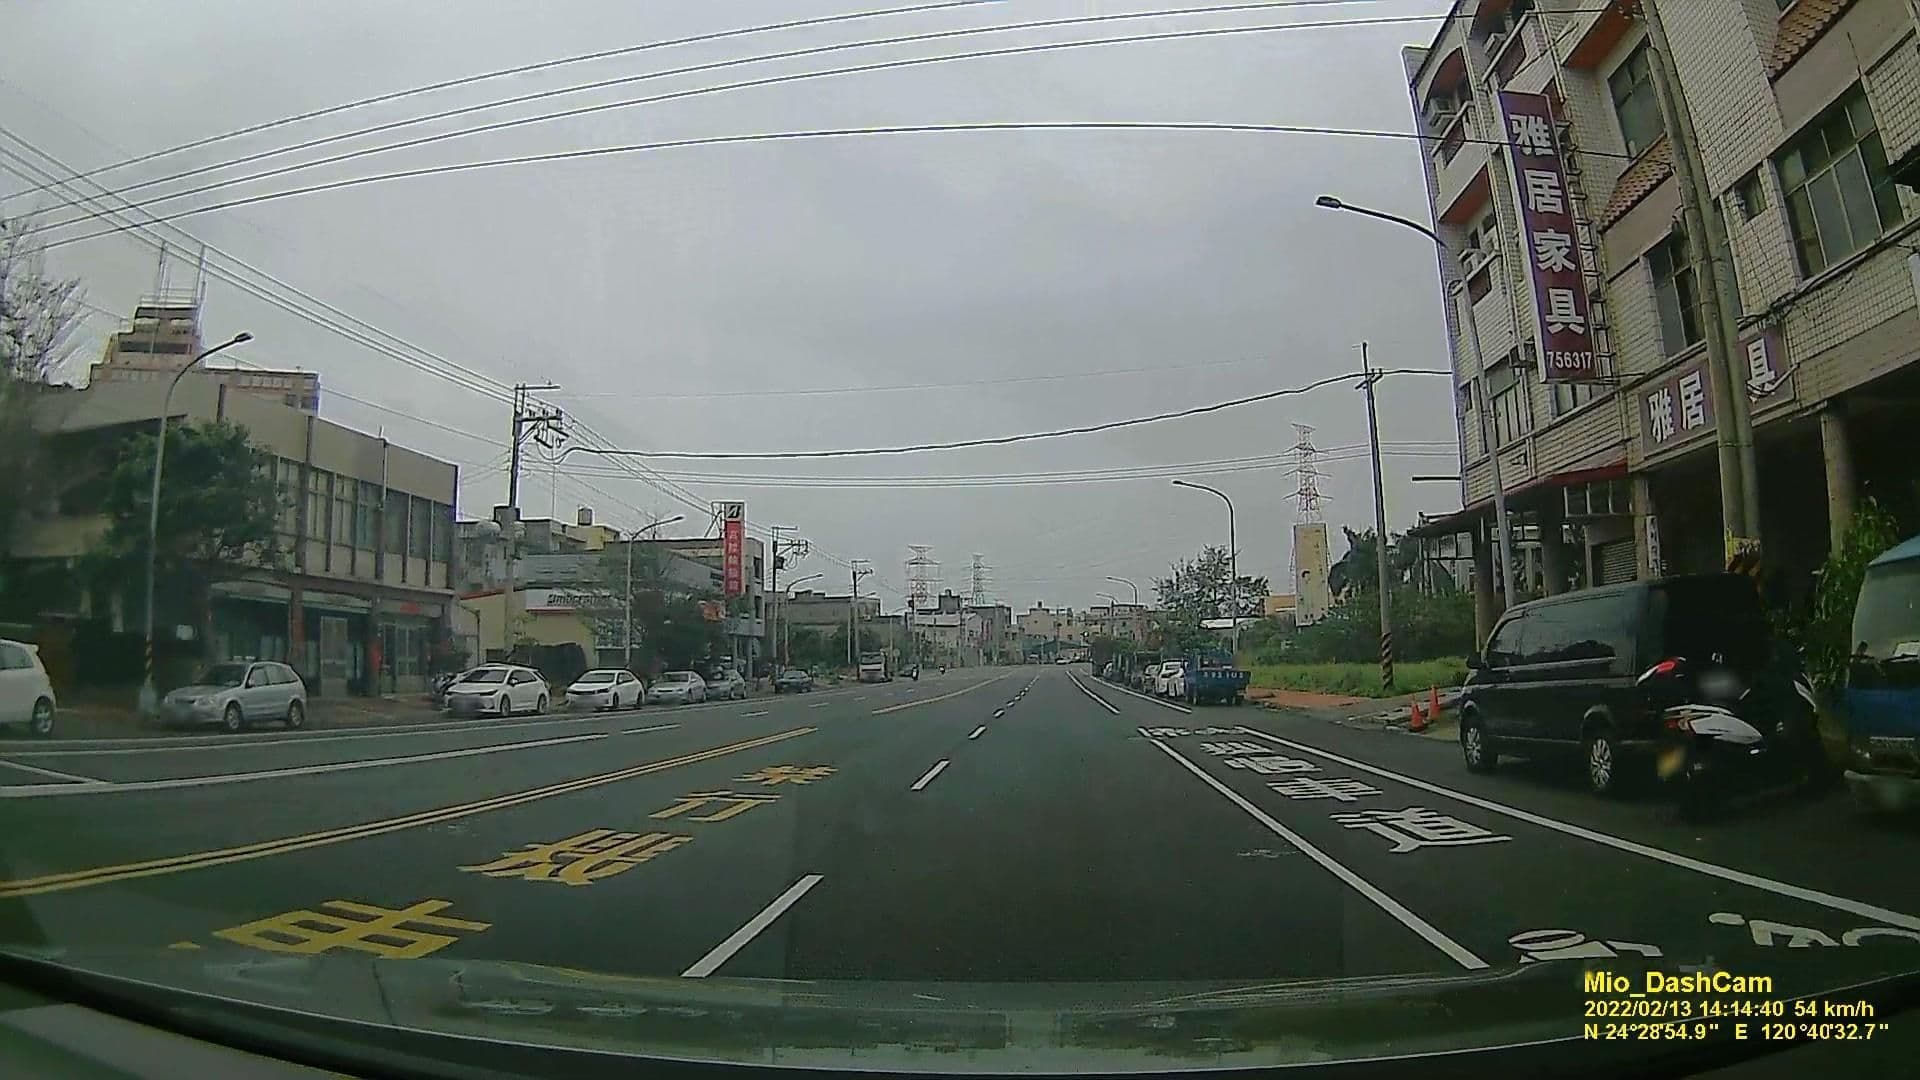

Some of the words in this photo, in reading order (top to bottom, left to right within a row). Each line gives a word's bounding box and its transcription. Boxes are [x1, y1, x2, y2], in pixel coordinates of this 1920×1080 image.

[1509, 114, 1585, 334] 雅居家具
[1546, 351, 1592, 369] 756317
[1648, 338, 1776, 444] 雅居具
[212, 763, 839, 960] 禁行機車
